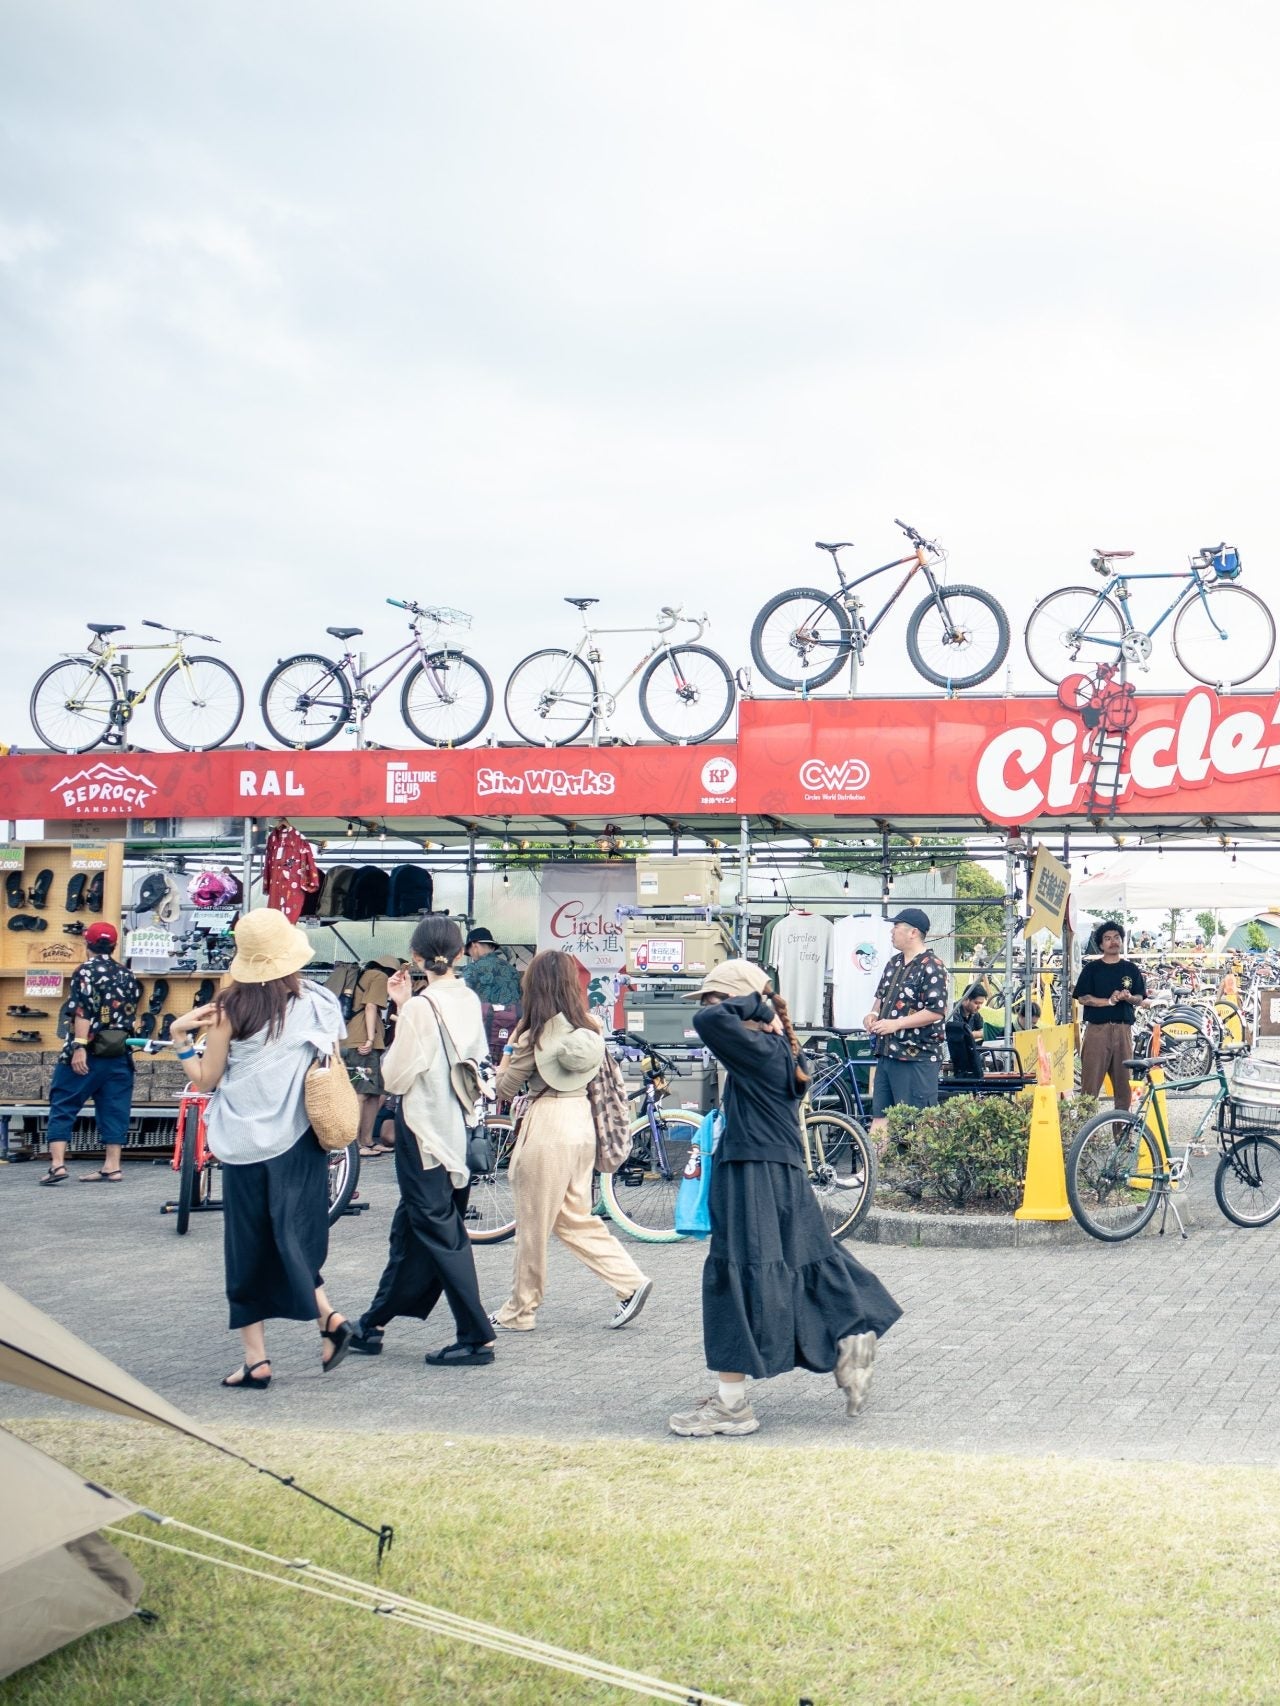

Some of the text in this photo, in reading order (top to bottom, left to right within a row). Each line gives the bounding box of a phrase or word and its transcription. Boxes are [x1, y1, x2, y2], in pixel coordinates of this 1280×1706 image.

[239, 770, 305, 797] RAL
[395, 771, 437, 783] CULTURE
[709, 769, 730, 783] KP
[799, 759, 871, 790] CWD
[62, 783, 151, 809] BEDROCK
[395, 782, 420, 800] CLUB
[822, 793, 836, 801] World
[837, 793, 866, 801] Distribution
[1037, 866, 1067, 909] 駐輪場
[550, 900, 623, 938] Circles
[787, 932, 817, 944] Circles
[800, 951, 820, 962] Unity
